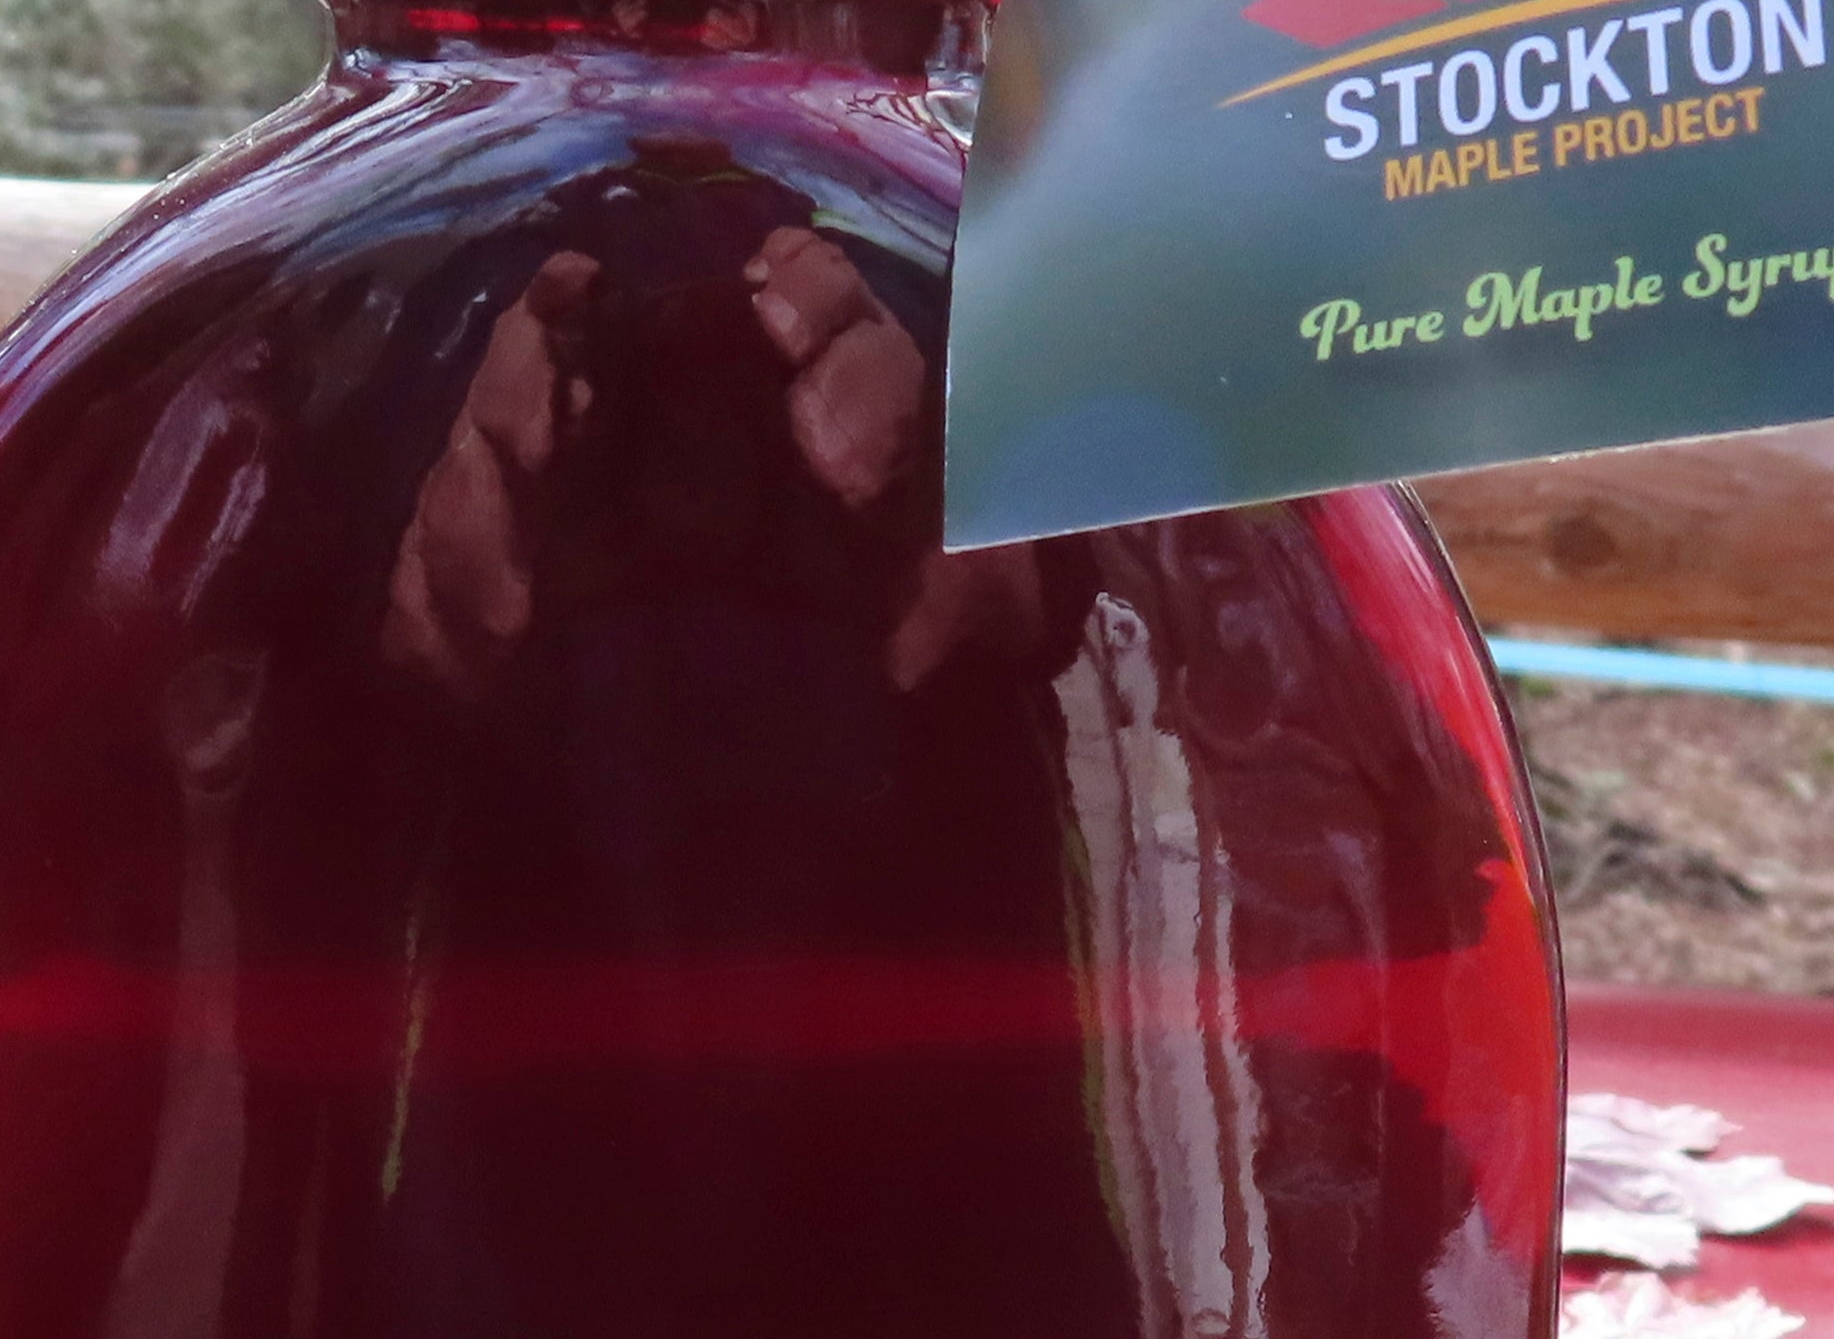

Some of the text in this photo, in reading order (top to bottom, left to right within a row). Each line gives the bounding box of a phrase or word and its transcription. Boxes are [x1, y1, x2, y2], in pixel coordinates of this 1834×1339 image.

[1383, 87, 1765, 201] MAPLE PROJECT
[1300, 298, 1444, 360] Pure
[1463, 257, 1665, 341] Maple
